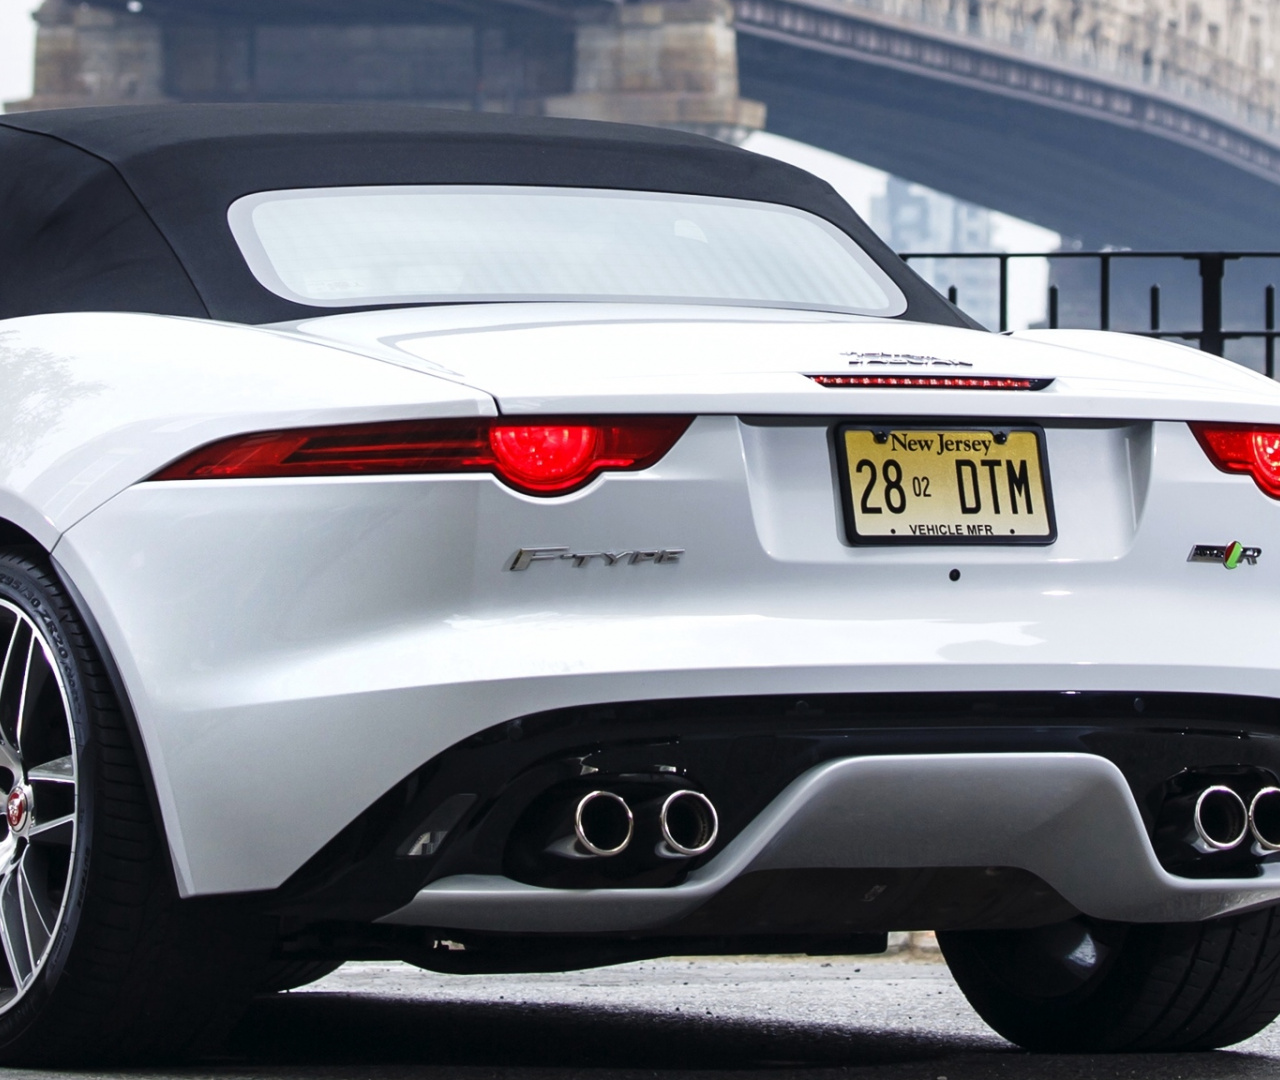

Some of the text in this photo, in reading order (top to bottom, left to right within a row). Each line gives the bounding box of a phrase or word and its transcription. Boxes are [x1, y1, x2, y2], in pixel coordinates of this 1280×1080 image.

[890, 433, 992, 456] New Jersey
[856, 458, 1034, 515] 28 02 DTM
[908, 524, 994, 536] VEHICLE MFR
